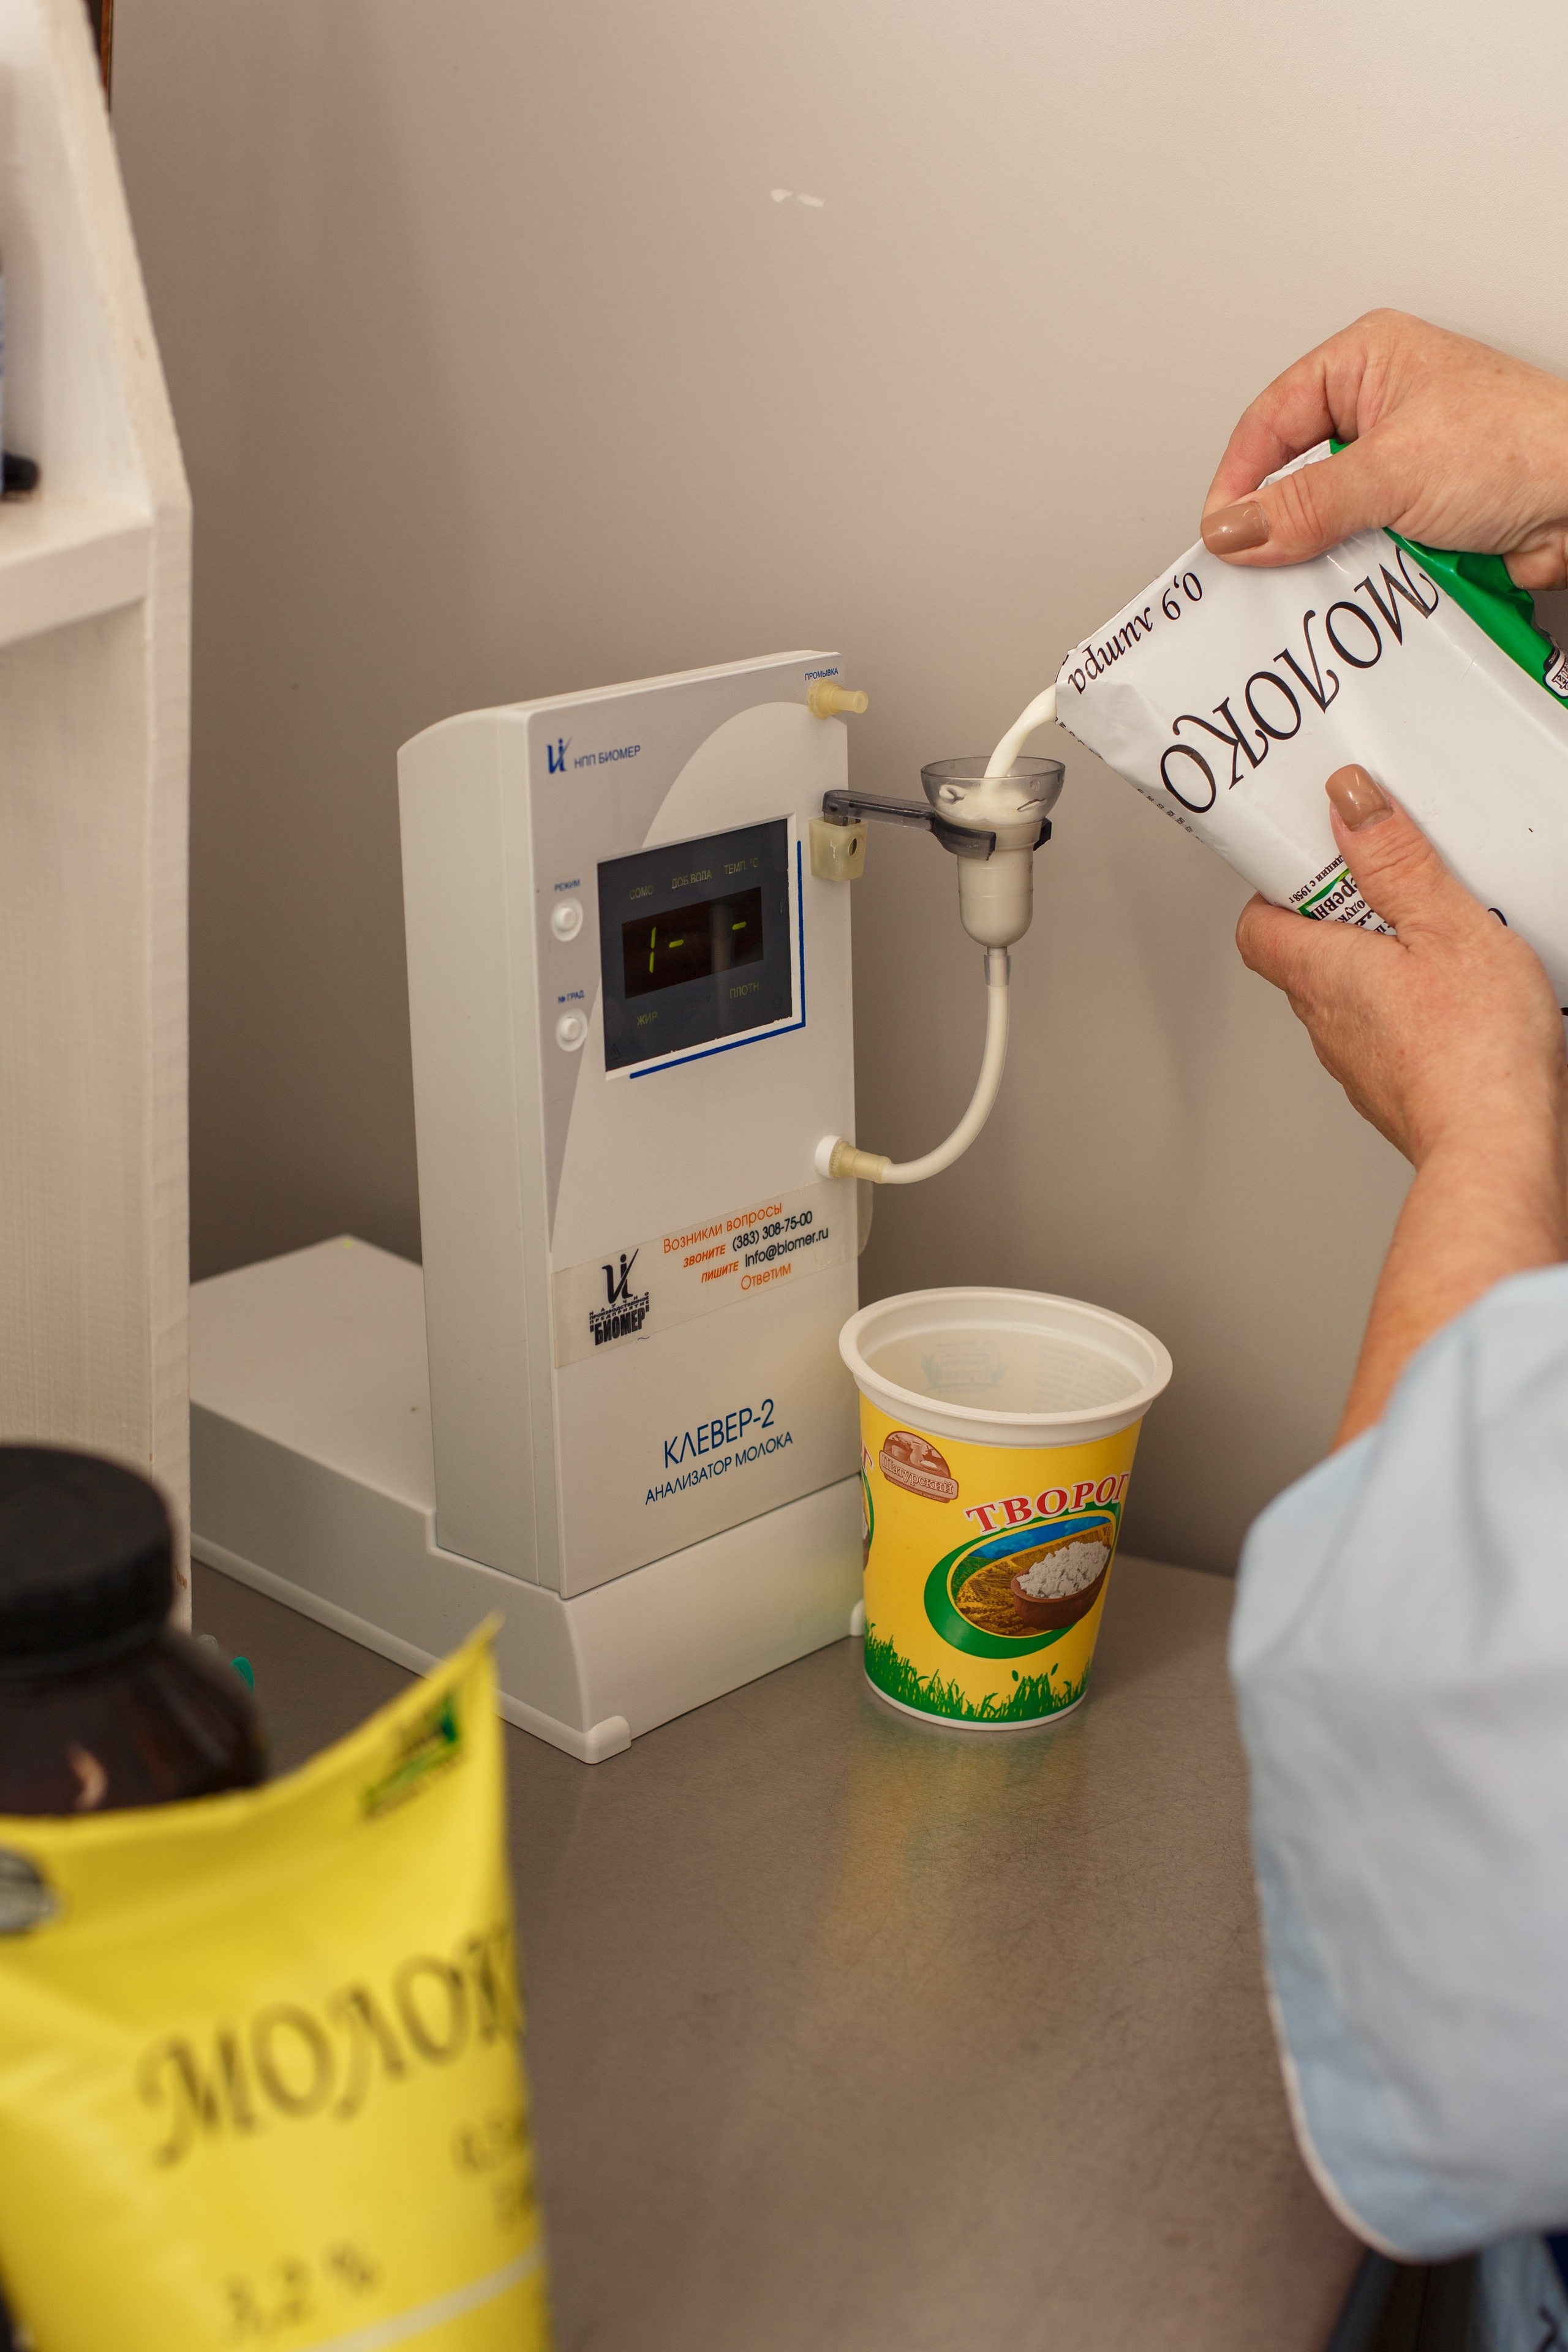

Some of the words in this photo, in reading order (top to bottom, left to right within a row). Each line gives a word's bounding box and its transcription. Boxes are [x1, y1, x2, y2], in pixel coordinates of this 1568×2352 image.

[1162, 572, 1203, 621] 0,9
[1068, 606, 1153, 695] литра
[805, 668, 838, 680] ПРОМЫВКА
[1160, 545, 1439, 813] МОЛОКО
[574, 754, 596, 769] НПП
[598, 745, 641, 764] БИОМЕР
[554, 879, 581, 892] РЕЖИМ
[1315, 854, 1344, 882] диции
[629, 884, 654, 900] СОМО
[1292, 884, 1312, 902] 1958
[1335, 900, 1366, 923] одук
[636, 1011, 658, 1026] ЖИР
[663, 1224, 723, 1254] Возникли
[726, 1203, 782, 1232] вопросы
[733, 1230, 760, 1251] (383)
[762, 1210, 813, 1240] 308-75-00
[745, 1227, 829, 1267] info@biomer.ru
[741, 1263, 791, 1290] Ответим
[589, 1295, 649, 1320] ПРОИЗВОДСТВЕННОЕ
[589, 1300, 650, 1325] ПРЕДПРИЯТИЕ
[590, 1304, 650, 1346] "БИОМЕР"
[665, 1398, 775, 1469] КЛЕВЕР-2
[645, 1457, 732, 1506] АНАЛИЗАТОР
[735, 1431, 793, 1467] МОЛОКА
[882, 1455, 954, 1496] Шатурский
[965, 1473, 1130, 1533] ТВОРОГ
[136, 1921, 526, 2169] МОЛОК
